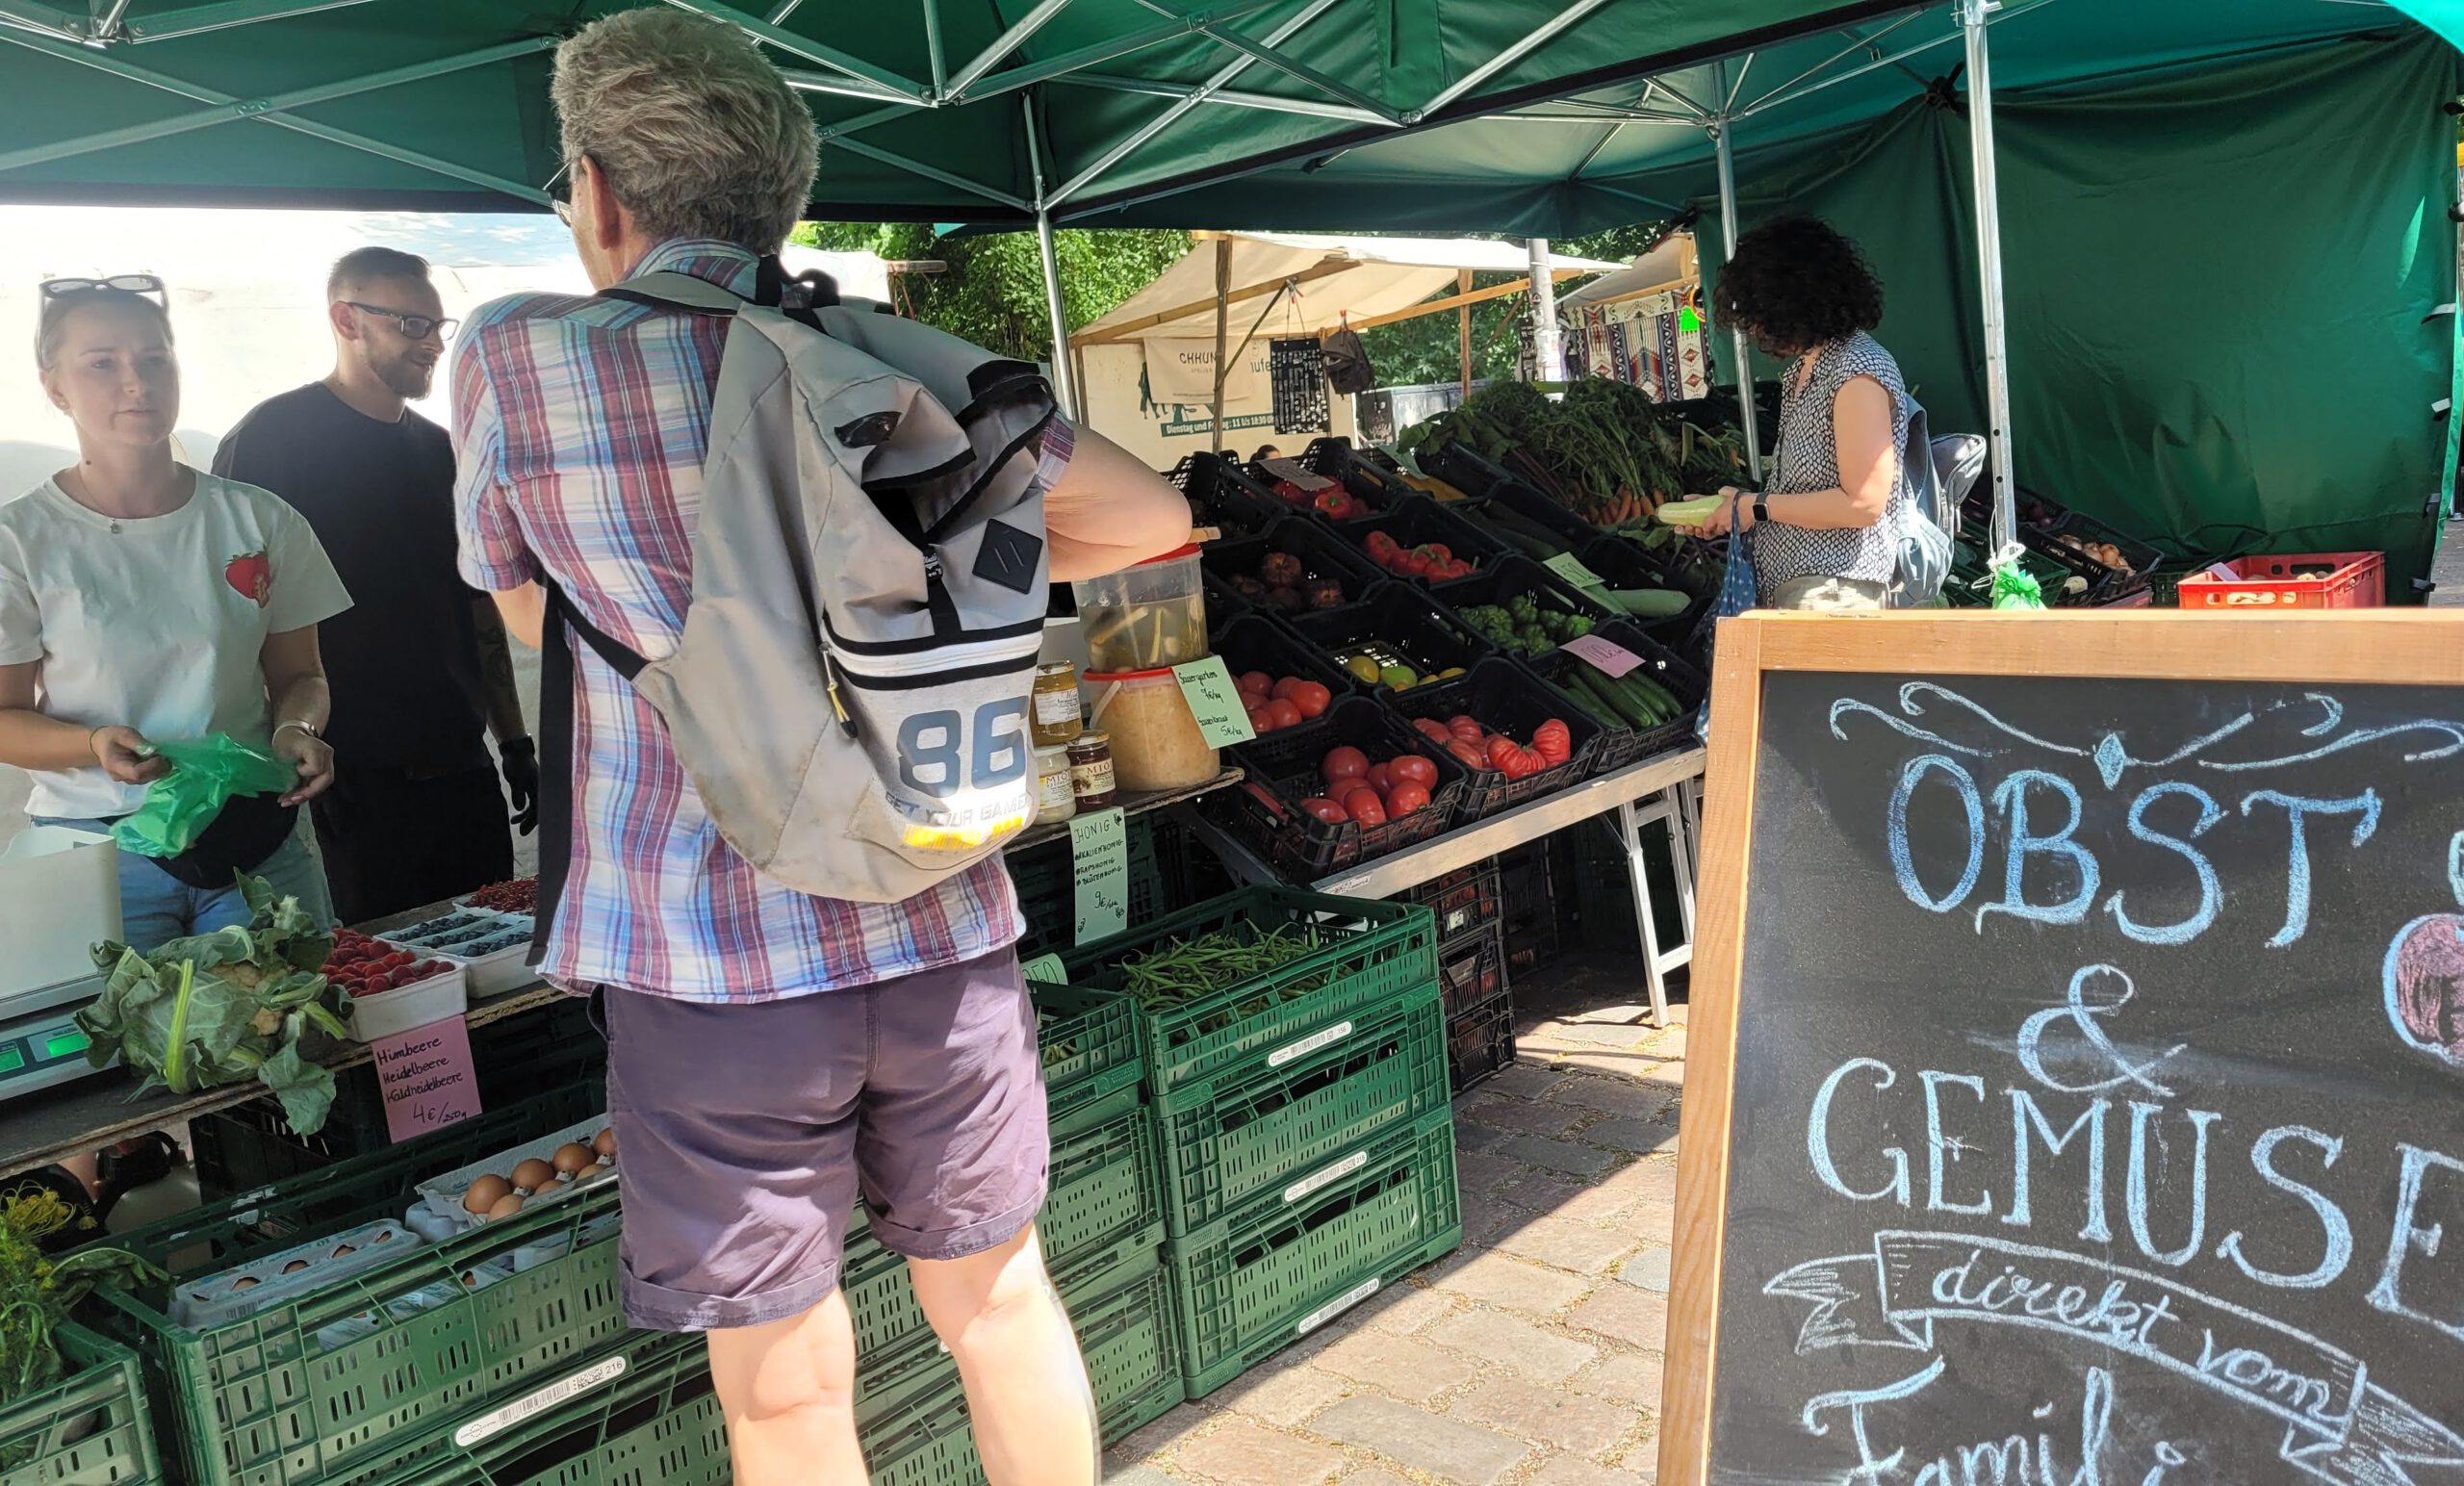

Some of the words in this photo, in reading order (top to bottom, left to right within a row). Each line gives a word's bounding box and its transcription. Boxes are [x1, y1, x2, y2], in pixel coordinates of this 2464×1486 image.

[1167, 421, 1194, 434] Dienstag
[1194, 420, 1206, 430] und
[896, 695, 1030, 799] 86
[886, 791, 920, 819] GET
[1074, 819, 1111, 844] HONIG
[1887, 754, 2382, 949] OBST
[2017, 963, 2188, 1098] &
[376, 1038, 443, 1065] Himbeere
[382, 1057, 450, 1085] Heidelbeere
[1932, 1248, 2180, 1347] direkt
[2196, 1328, 2348, 1422] vom
[605, 1360, 623, 1375] 216
